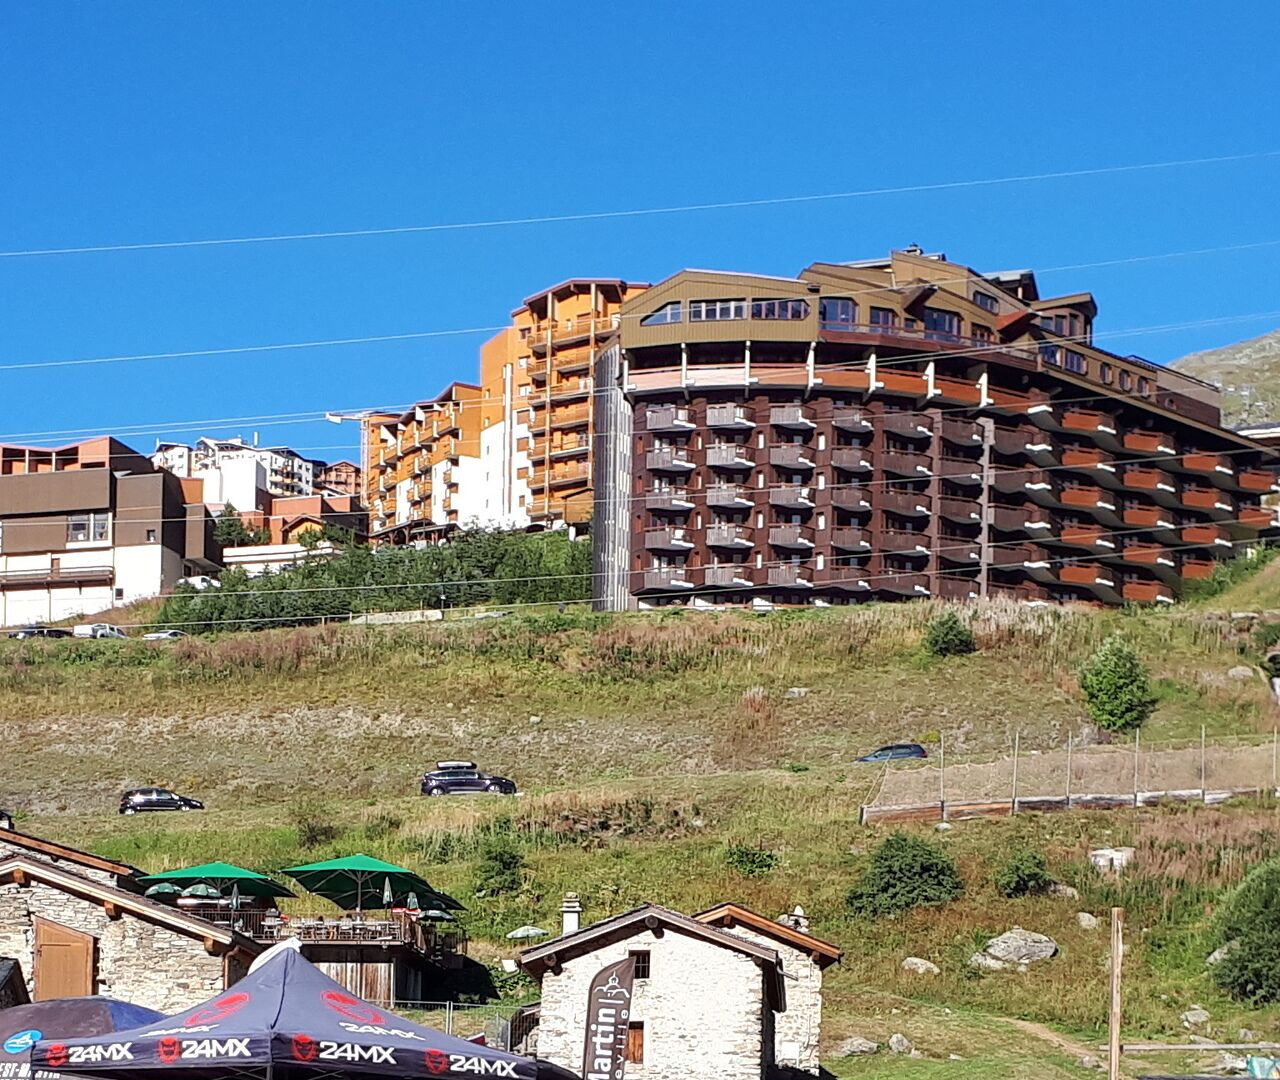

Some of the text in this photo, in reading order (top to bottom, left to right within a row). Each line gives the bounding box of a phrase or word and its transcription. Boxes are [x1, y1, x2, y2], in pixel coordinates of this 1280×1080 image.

[68, 1041, 135, 1063] 24MX
[181, 1037, 252, 1059] 24MX
[319, 1041, 398, 1065] 24MX
[448, 1054, 520, 1079] 24MX
